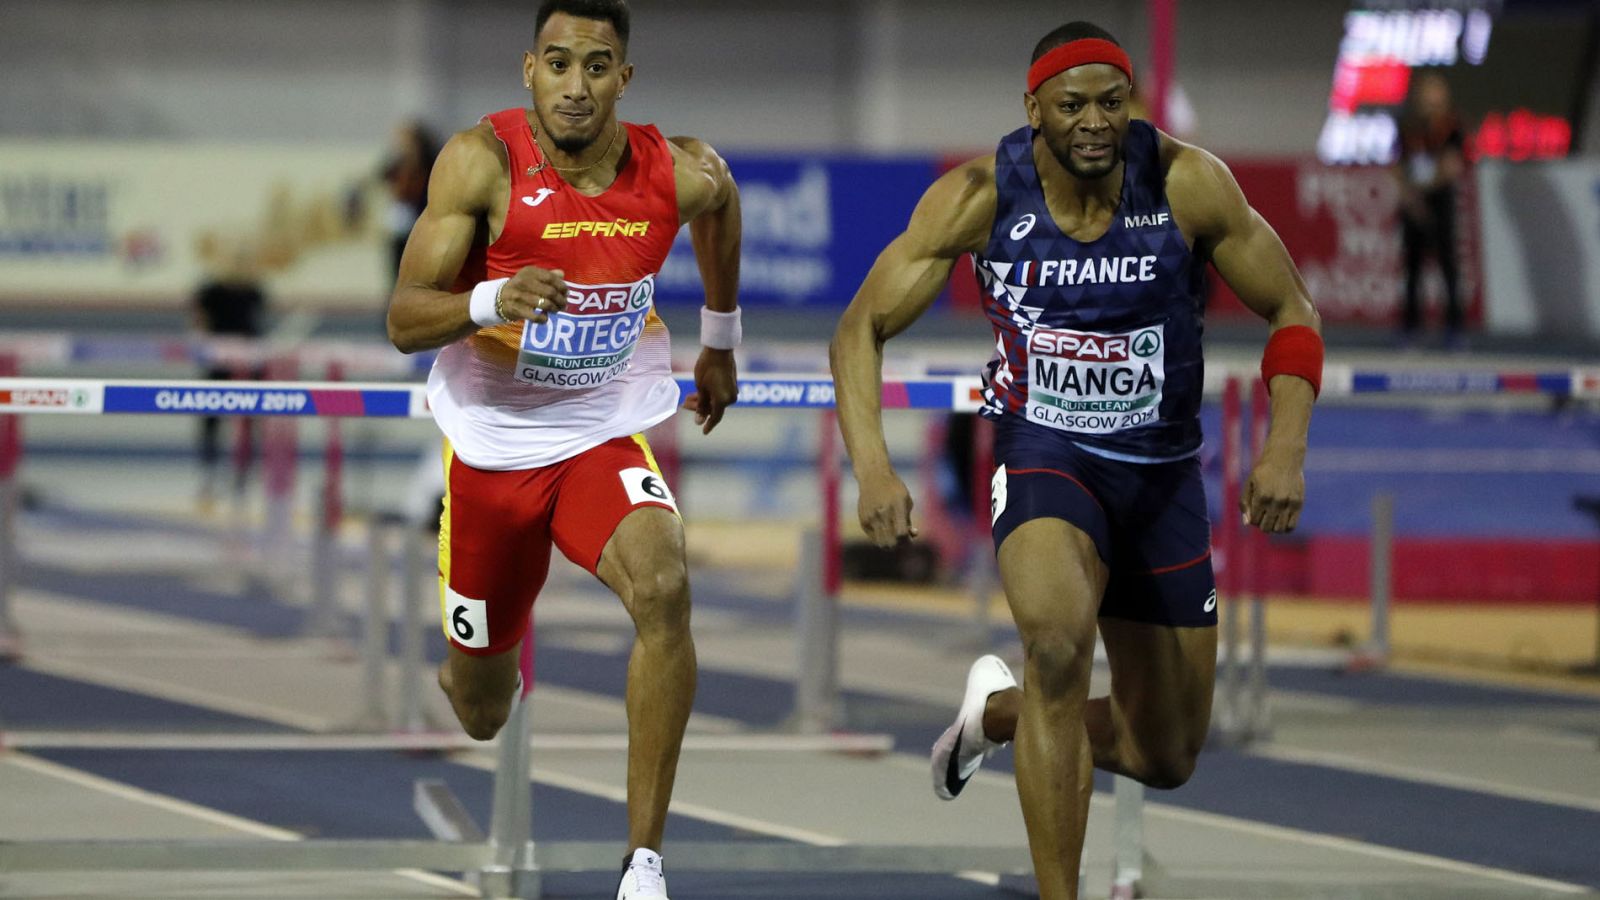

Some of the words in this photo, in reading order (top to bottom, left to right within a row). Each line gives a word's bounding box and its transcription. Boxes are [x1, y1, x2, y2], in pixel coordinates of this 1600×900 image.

[541, 218, 650, 239] ESPAÑA
[1124, 213, 1169, 228] MAIF
[1039, 255, 1157, 287] FRANCE
[566, 290, 626, 312] PAR
[529, 312, 644, 353] ORTEGA
[1032, 333, 1126, 359] SPAR
[555, 358, 582, 368] RUN
[583, 355, 619, 367] CLEAN
[522, 367, 606, 386] GLASGOW
[1035, 358, 1157, 396] MANGA
[155, 389, 259, 410] GLASGOW
[262, 391, 307, 410] 2019
[1061, 400, 1087, 411] RUN
[1090, 401, 1131, 412] CLEAN
[1033, 406, 1117, 429] GLASGOW
[641, 476, 668, 499] 6
[452, 605, 474, 641] 6
